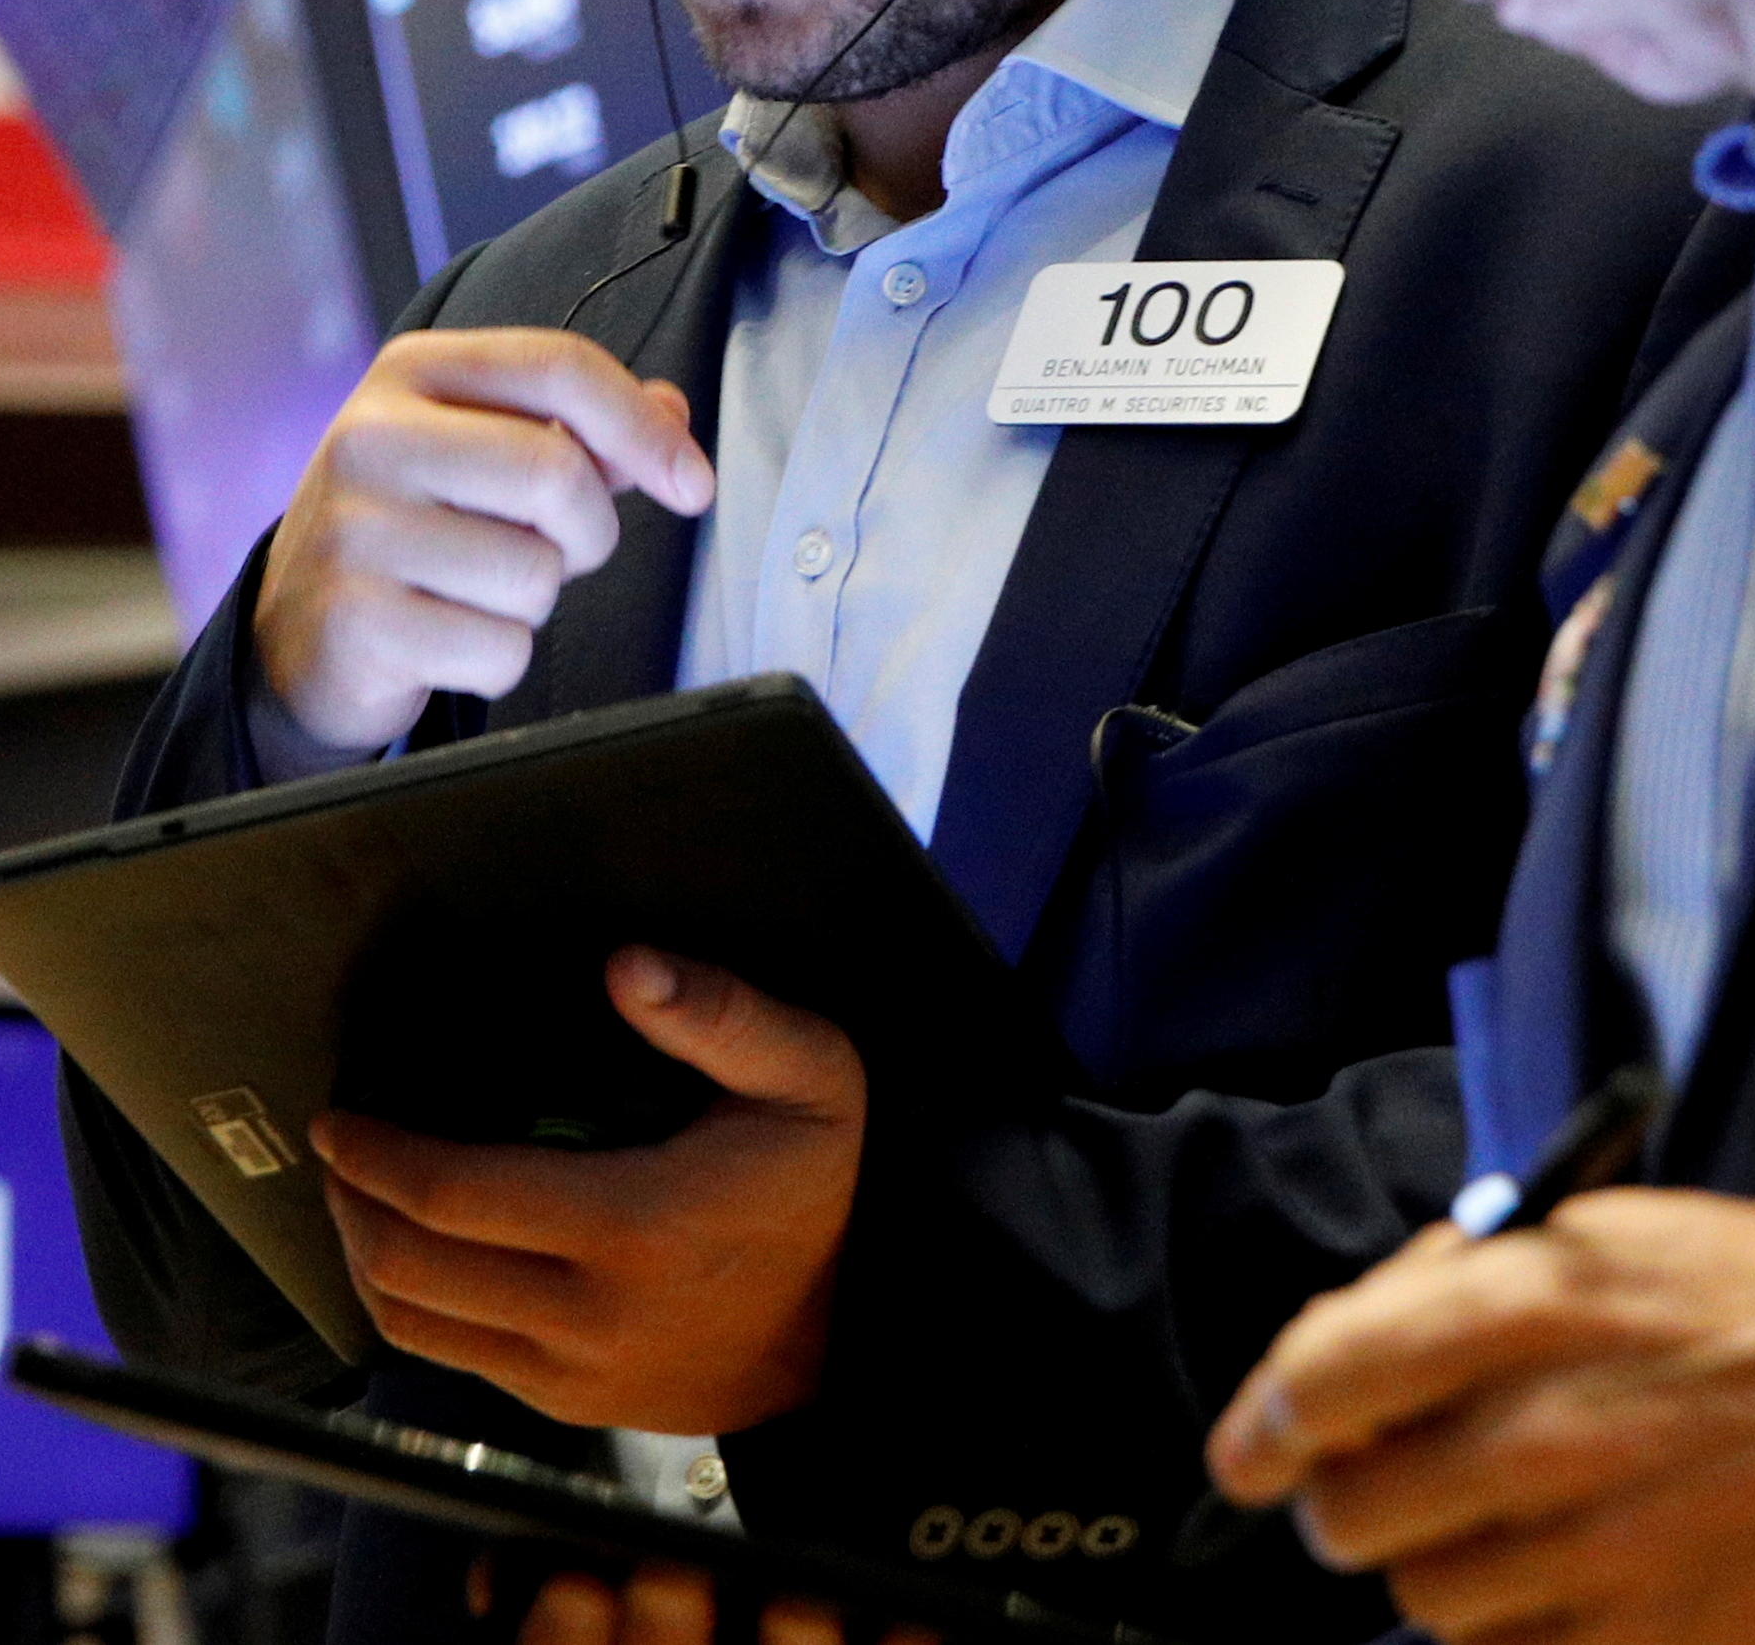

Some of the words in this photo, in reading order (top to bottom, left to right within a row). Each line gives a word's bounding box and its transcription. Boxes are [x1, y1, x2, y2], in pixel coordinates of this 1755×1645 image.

[1098, 279, 1255, 347] 100
[1041, 357, 1151, 378] BENJAMIN
[1162, 356, 1267, 376] TUCHMAN
[1009, 396, 1091, 414] QUATTRO
[1098, 396, 1117, 414] M
[1125, 395, 1227, 414] SECURITIES
